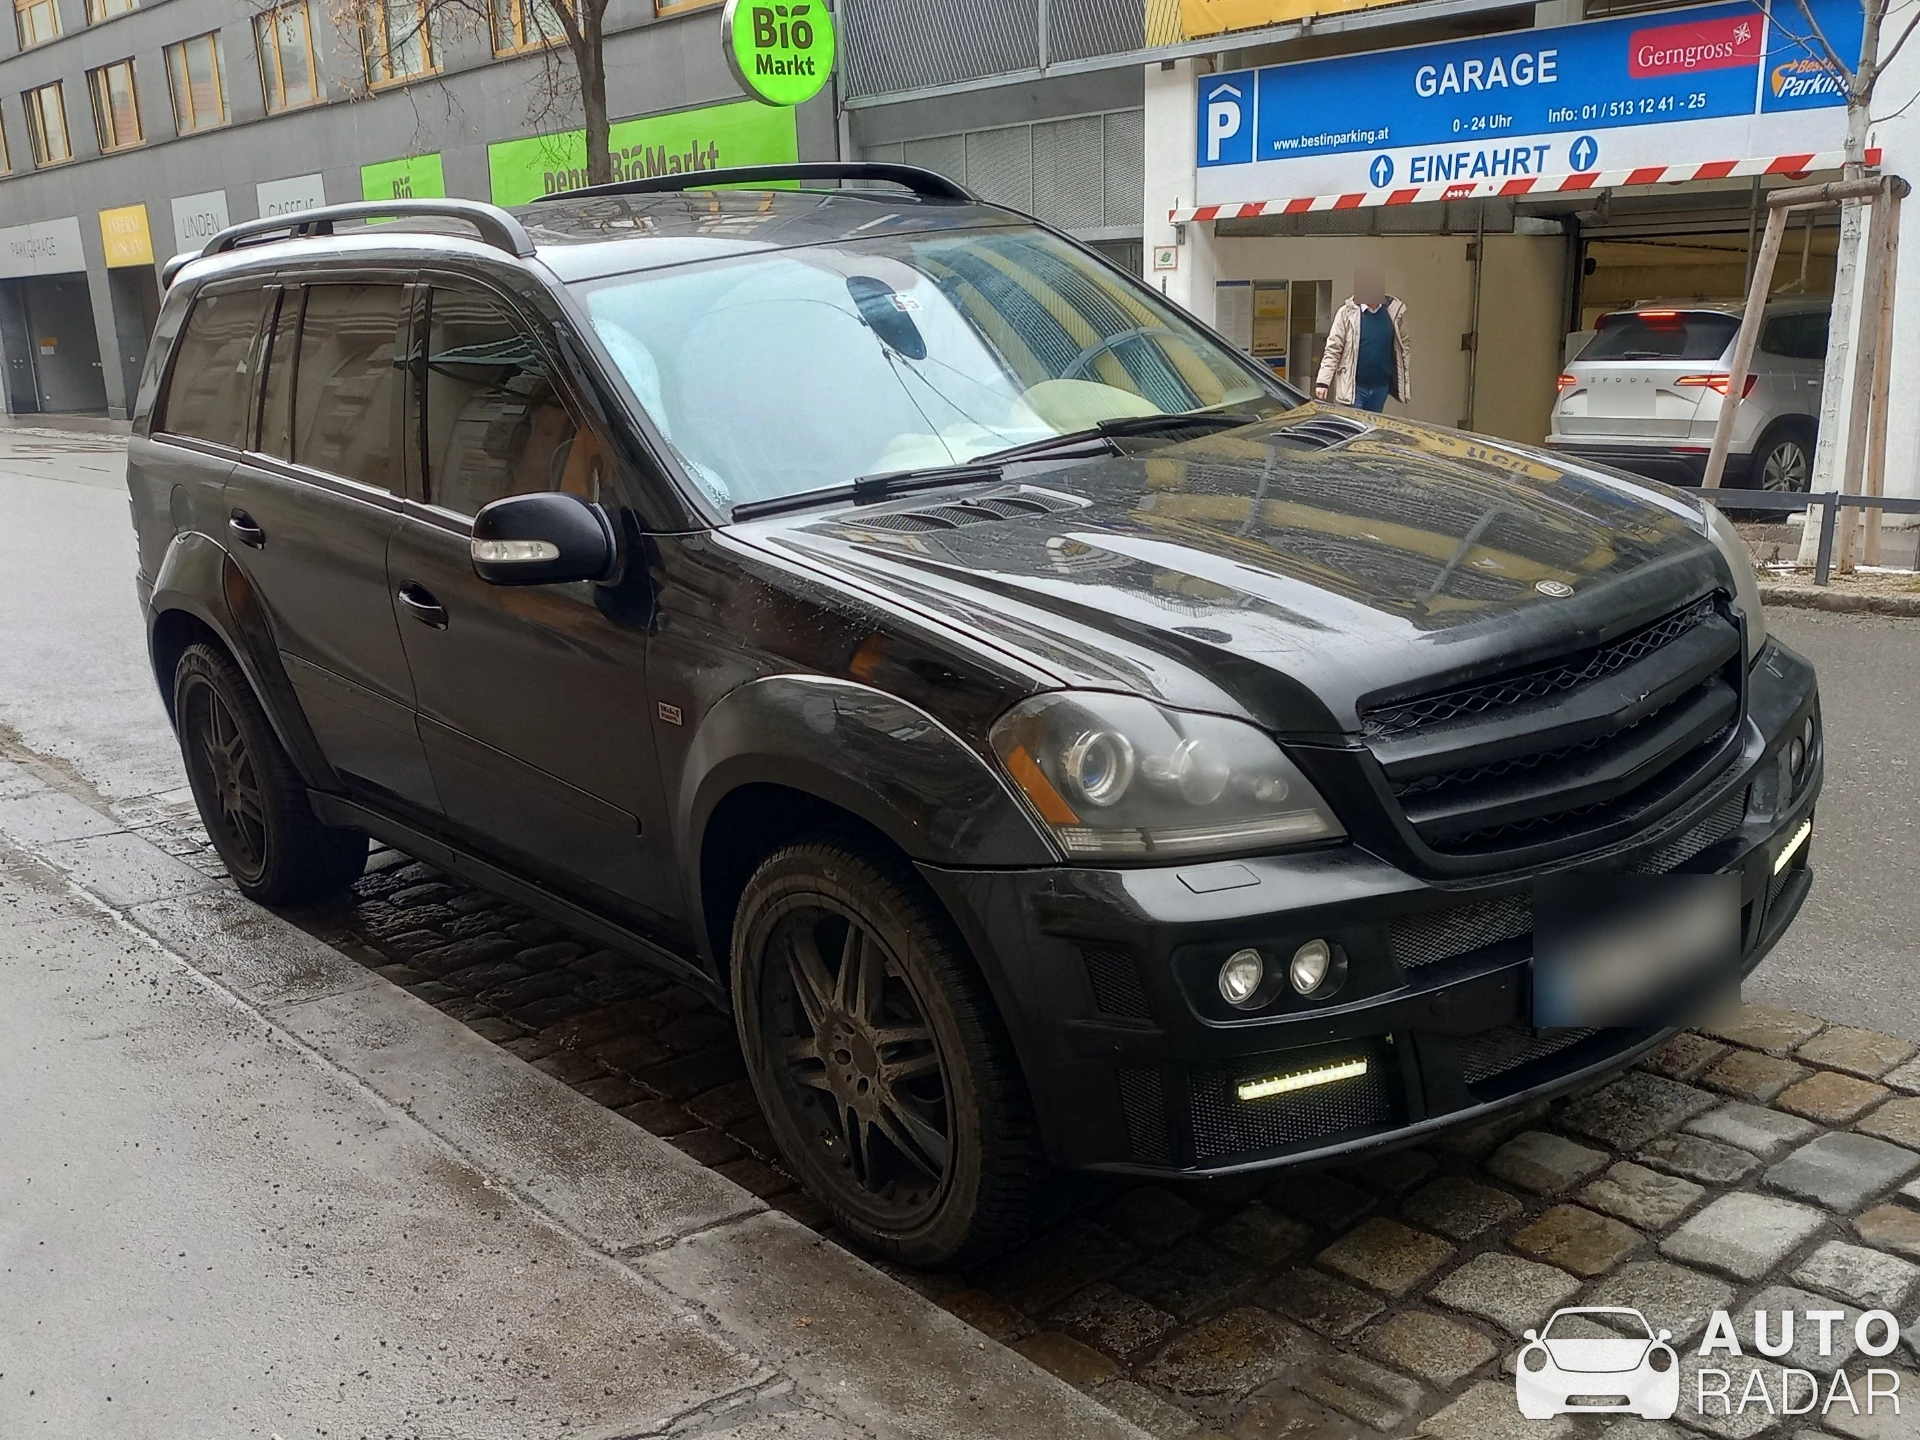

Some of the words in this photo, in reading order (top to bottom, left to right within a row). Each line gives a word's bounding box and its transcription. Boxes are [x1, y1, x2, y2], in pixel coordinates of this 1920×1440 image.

[753, 5, 814, 49] Bio
[756, 53, 815, 76] Markt
[1637, 41, 1733, 67] Gerngross
[1415, 49, 1558, 97] GARAGE
[1548, 108, 1578, 123] Info:
[1582, 104, 1597, 120] 01
[1609, 101, 1634, 116] 513
[1639, 98, 1654, 113] 12
[1657, 96, 1674, 111] 41
[1688, 93, 1706, 109] 25
[1207, 101, 1241, 161] P
[1453, 118, 1460, 133] 0
[1471, 115, 1486, 131] 24
[1489, 114, 1513, 128] Uhr
[1273, 126, 1390, 151] www.bestinparking.at
[1410, 144, 1551, 183] EINFAHRT
[182, 213, 221, 239] LINDEN
[10, 236, 57, 260] PARKGARAGE
